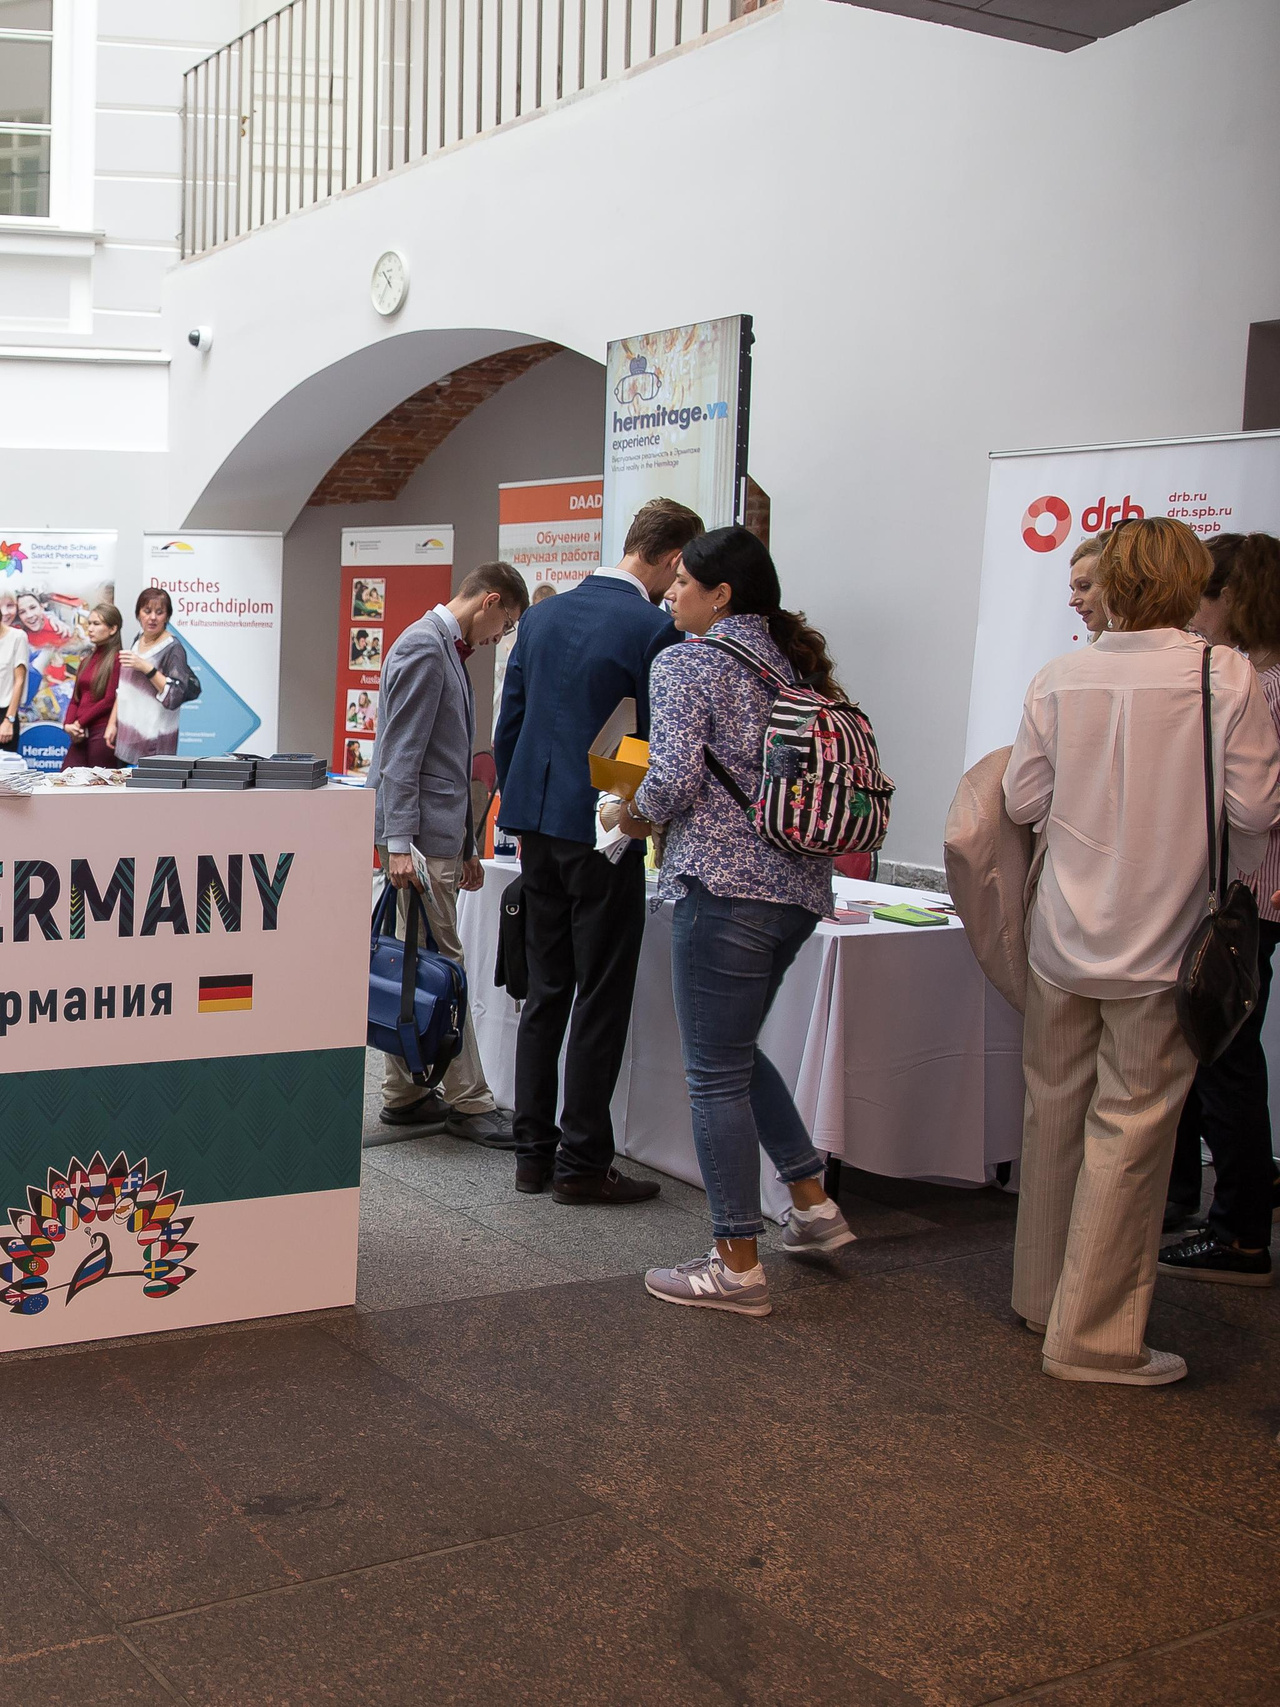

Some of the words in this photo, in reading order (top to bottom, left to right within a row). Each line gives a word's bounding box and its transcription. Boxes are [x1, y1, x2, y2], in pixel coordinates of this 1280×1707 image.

[613, 401, 728, 433] hermitage.VR
[612, 434, 660, 452] experience
[569, 494, 603, 510] DAAD
[1168, 491, 1208, 503] drb.ru
[1167, 506, 1233, 519] drb.spb.ru
[31, 543, 68, 551] Deutsche
[69, 543, 97, 551] Schule
[536, 530, 591, 548] Обучение
[593, 531, 601, 541] и
[55, 552, 99, 561] Petersburg
[513, 552, 558, 566] научная
[560, 548, 600, 565] работа
[535, 571, 542, 581] в
[150, 577, 221, 593] Deutsches
[178, 597, 274, 617] Sprachdiplom
[22, 745, 69, 757] Herzlich
